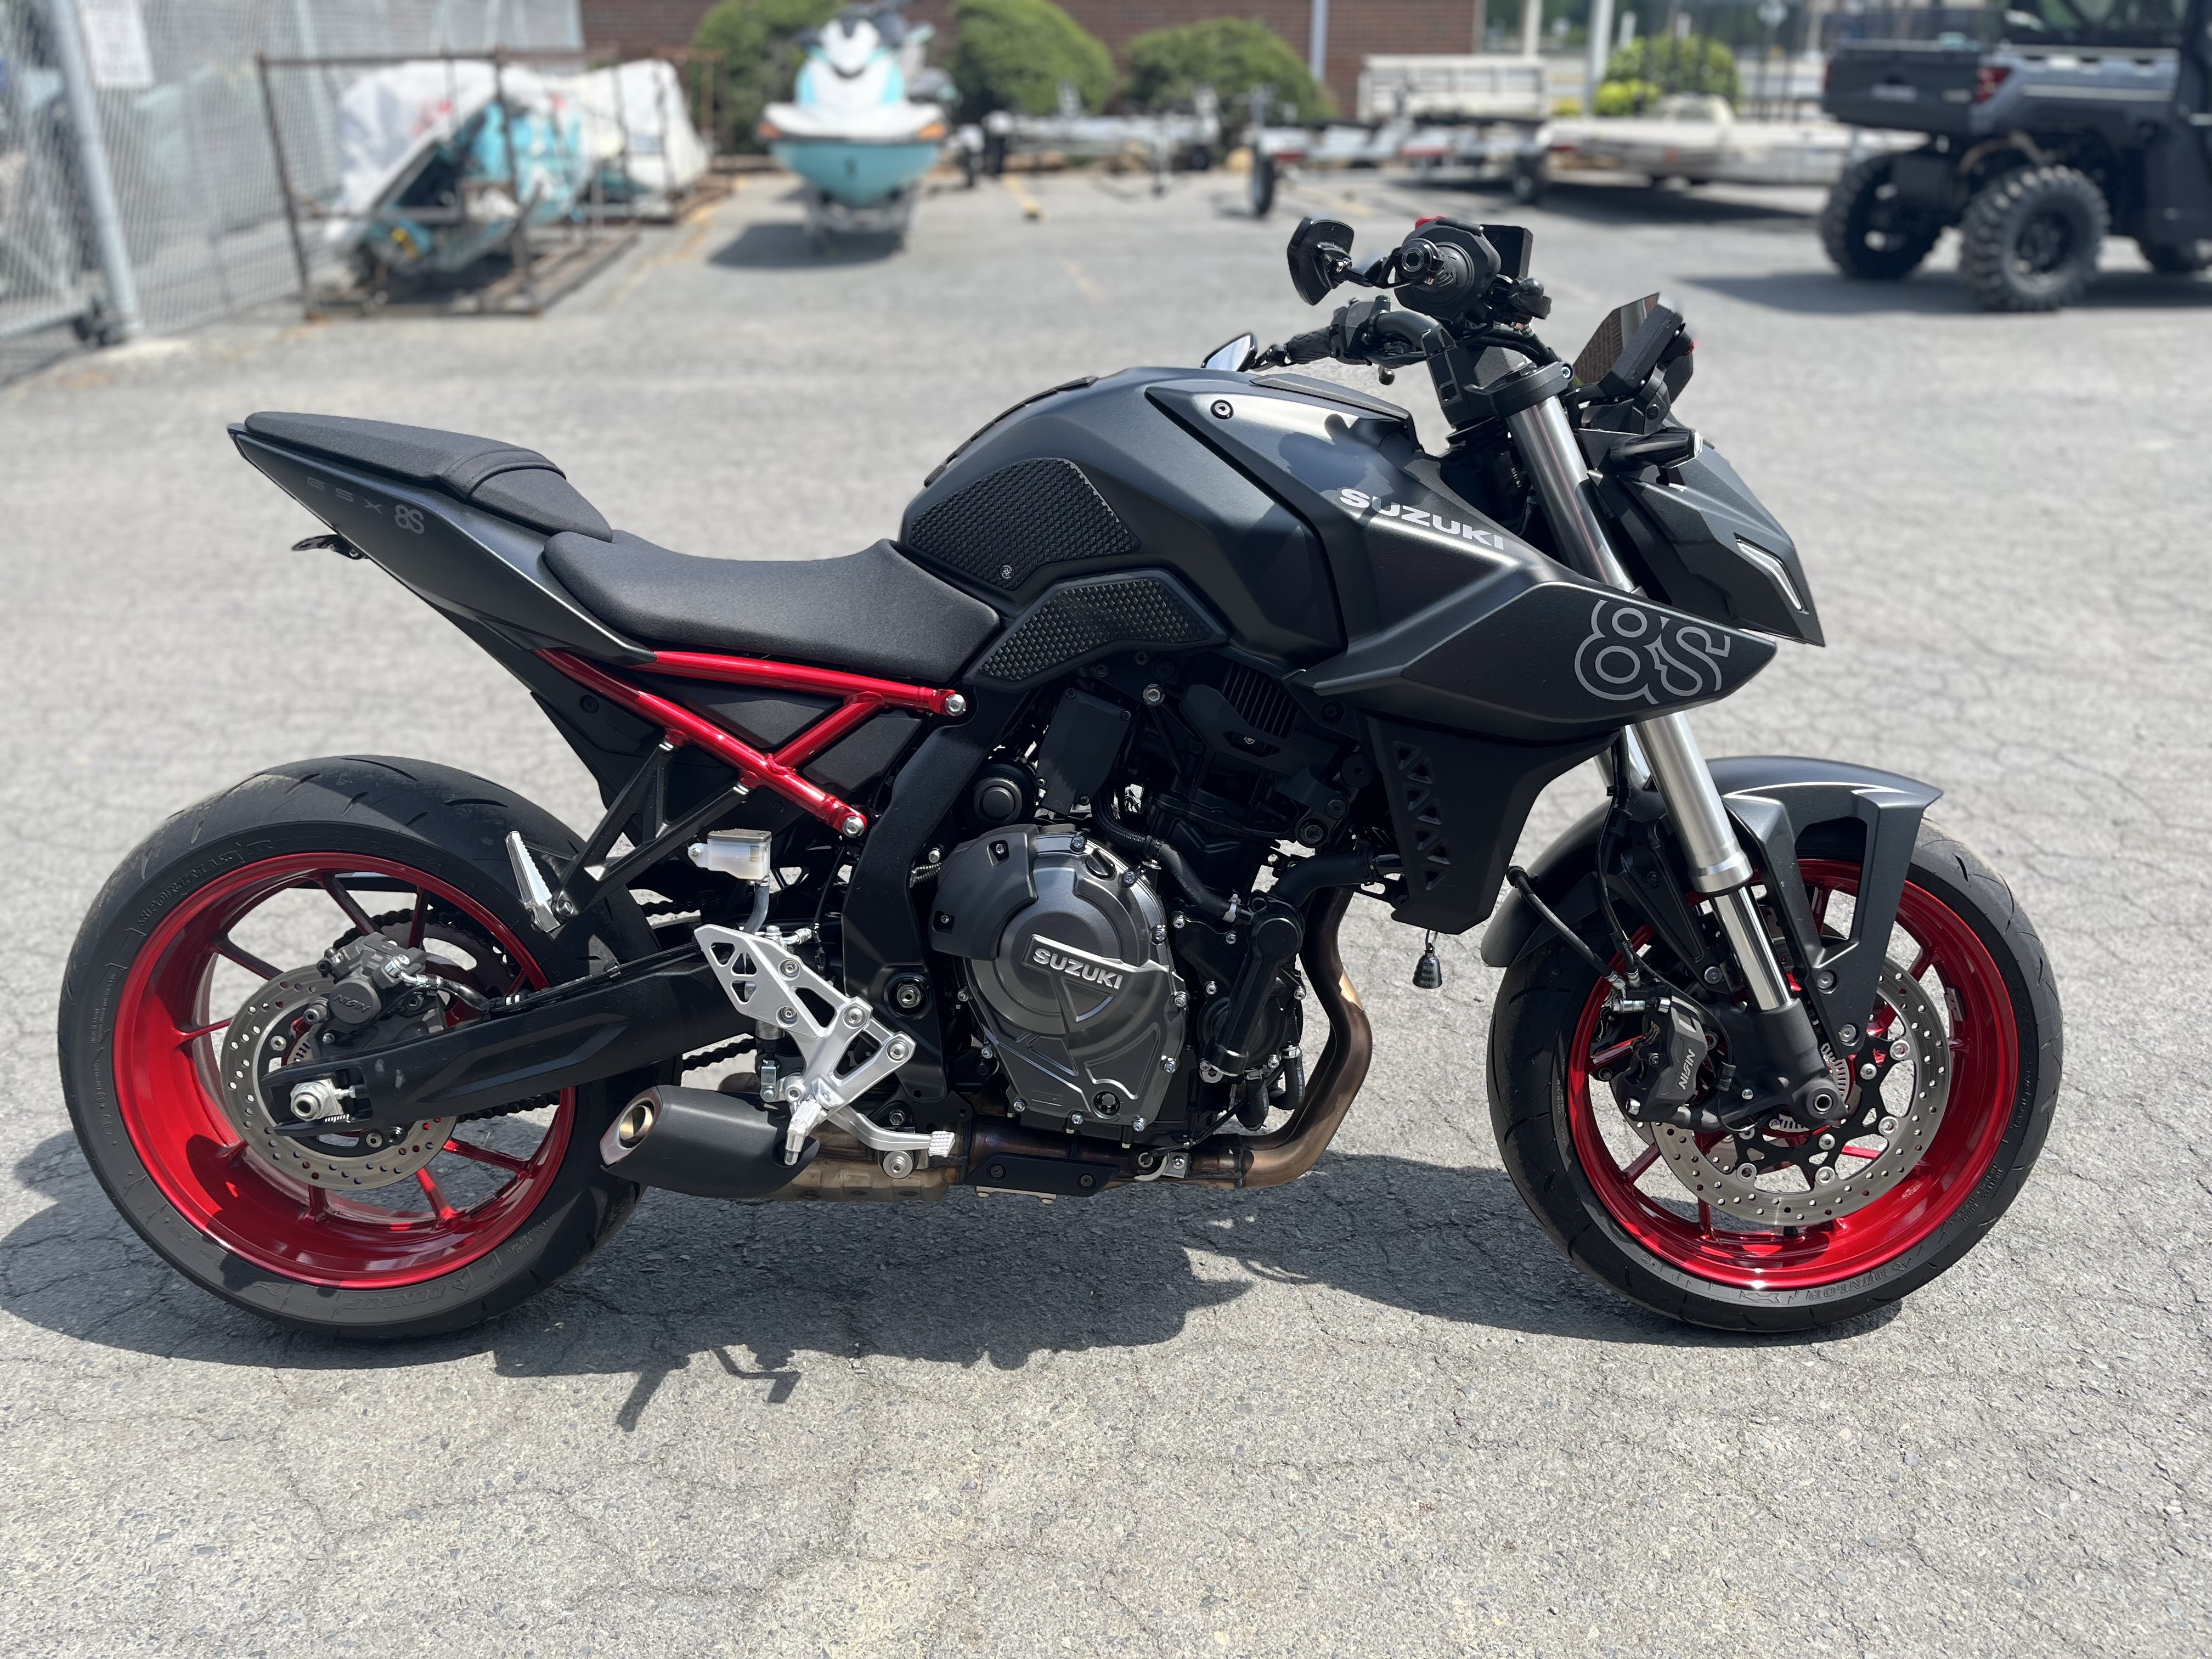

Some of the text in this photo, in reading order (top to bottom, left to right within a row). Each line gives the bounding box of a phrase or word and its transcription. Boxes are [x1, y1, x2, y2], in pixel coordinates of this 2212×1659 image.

[1340, 488, 1504, 550] SUZUKI
[1033, 948, 1123, 989] SUZUKI
[333, 994, 371, 1013] NISSIN
[1678, 1048, 1695, 1090] NISSIN
